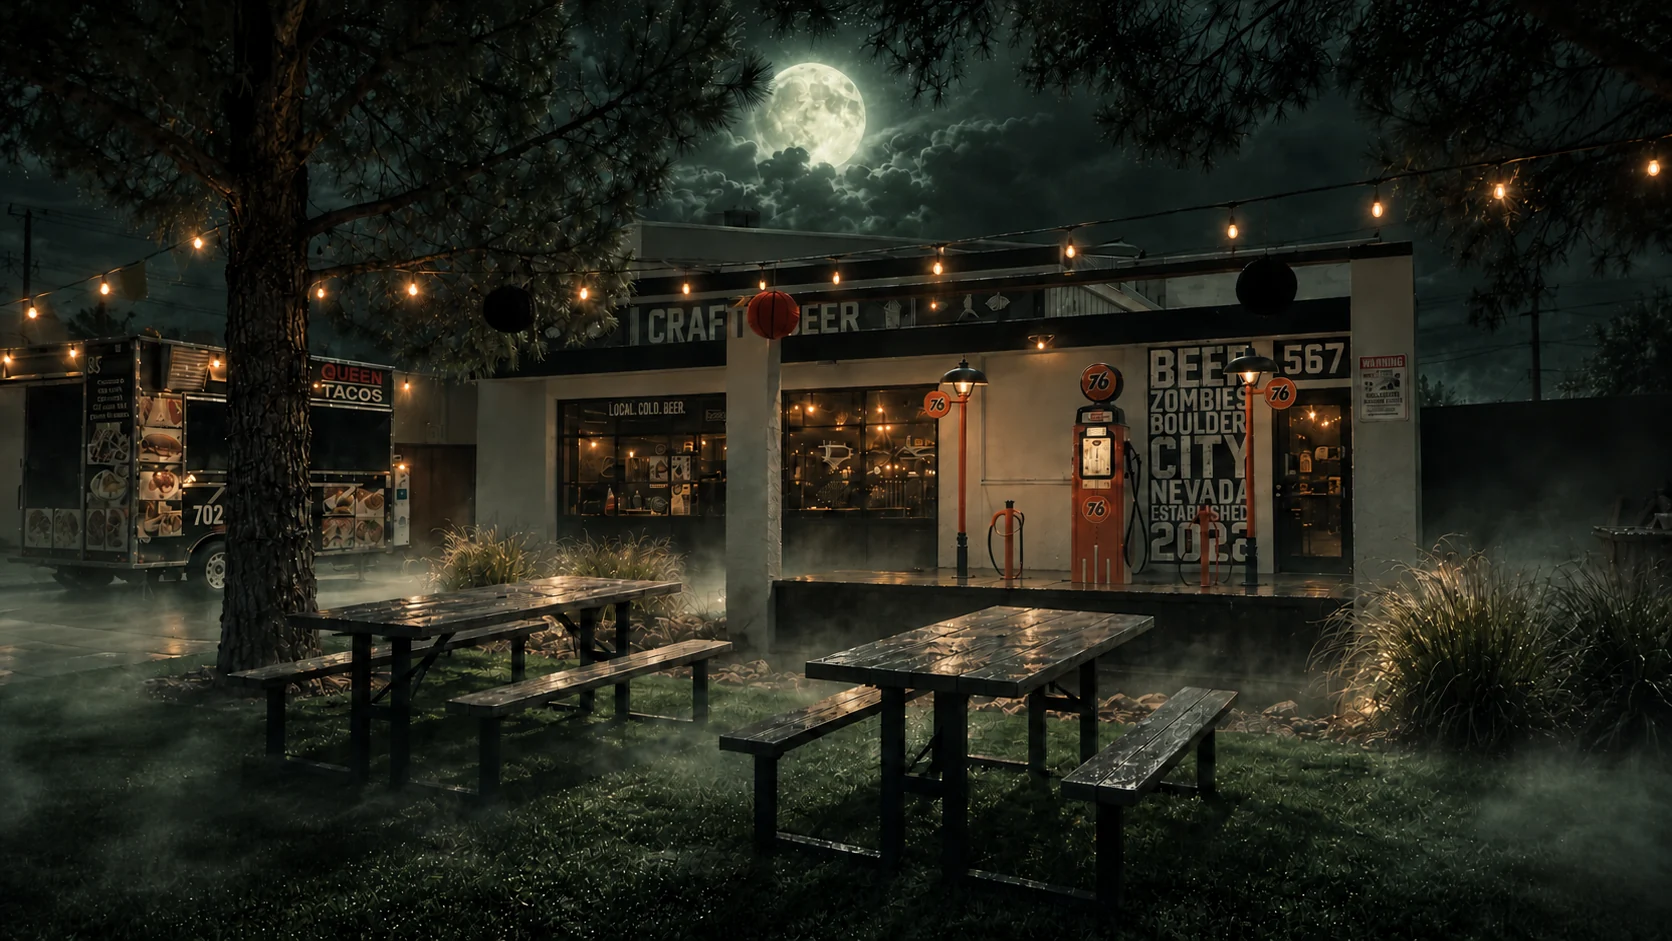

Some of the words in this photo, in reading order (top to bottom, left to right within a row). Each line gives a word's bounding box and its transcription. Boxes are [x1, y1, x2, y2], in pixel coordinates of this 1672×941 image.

[790, 301, 860, 337] EER
[1284, 342, 1345, 375] 567
[1361, 356, 1403, 368] WARNING
[321, 363, 383, 385] QUEEN
[1088, 371, 1110, 391] 76
[321, 383, 383, 403] TACOS
[1150, 388, 1246, 413] ZOMBIES
[1270, 384, 1290, 402] 76
[608, 401, 637, 417] LOCAL.
[638, 401, 661, 415] COLD.
[663, 400, 686, 415] BEER.
[928, 396, 945, 412] 76
[1150, 411, 1247, 435] BOULDER
[1150, 434, 1247, 479] CITY
[1150, 479, 1247, 504] NEVADA
[192, 504, 224, 526] 702
[1086, 500, 1106, 517] 76
[1150, 504, 1248, 521] ESTABSHED
